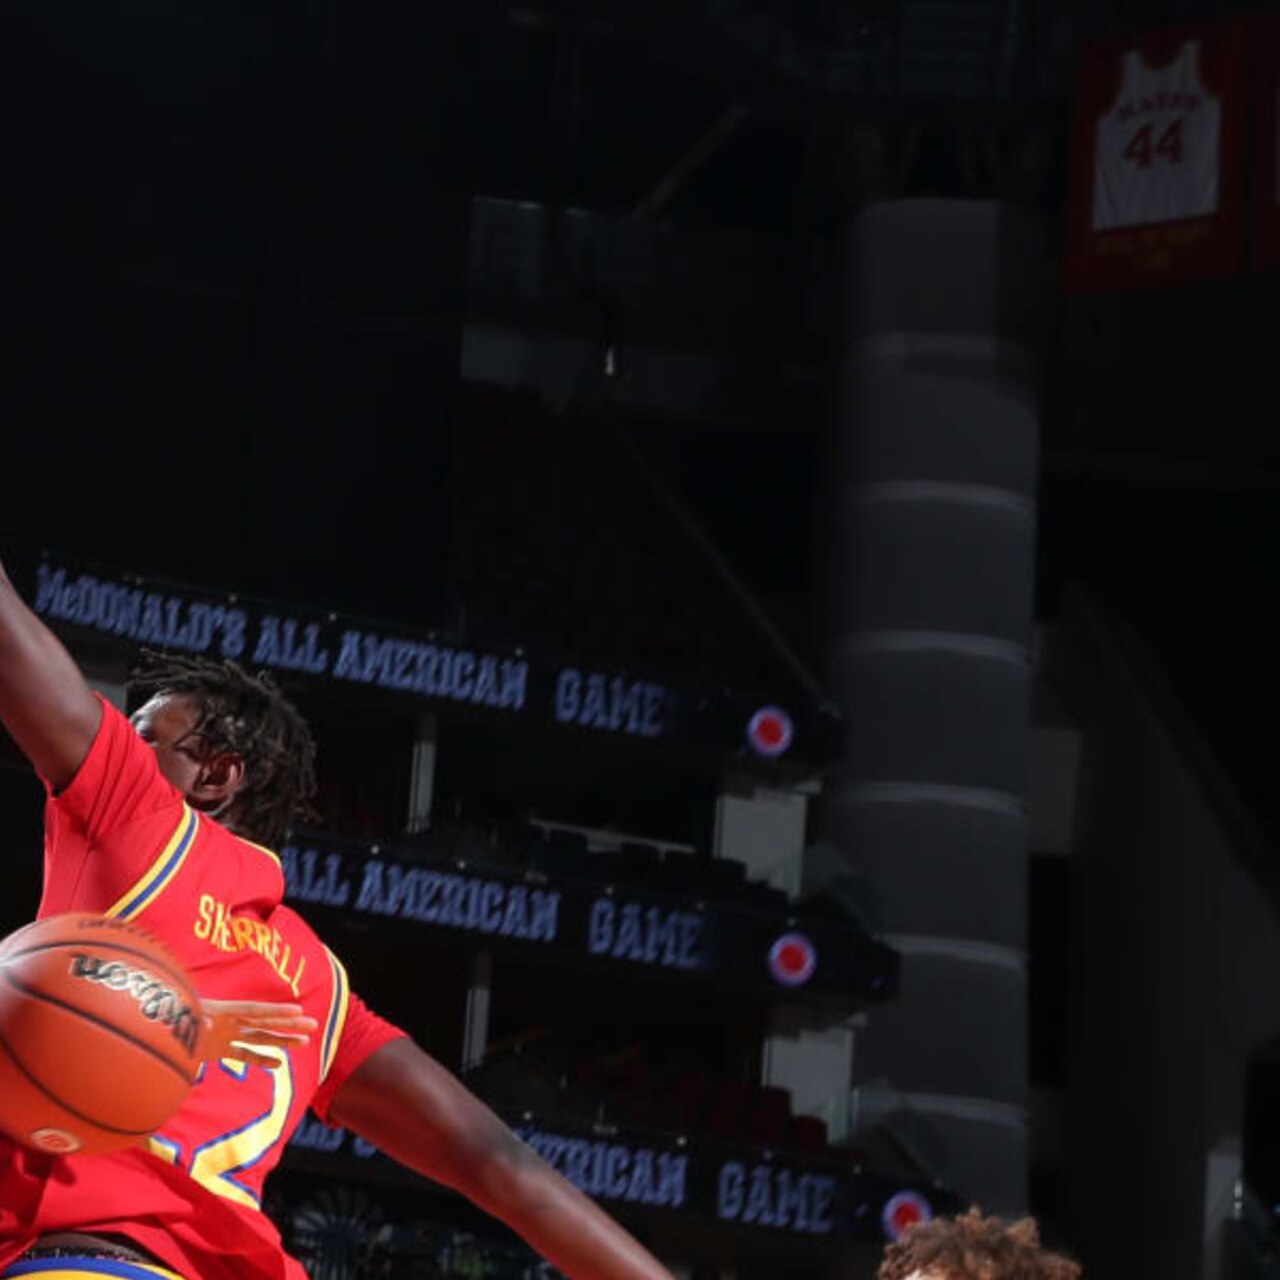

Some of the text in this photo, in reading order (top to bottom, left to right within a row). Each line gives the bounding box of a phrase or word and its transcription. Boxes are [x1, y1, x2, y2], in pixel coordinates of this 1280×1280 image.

[1123, 118, 1183, 170] 44
[251, 614, 330, 675] ALL
[332, 628, 530, 713] AMERICAN
[554, 667, 666, 740] GAME
[193, 892, 306, 999] SHERRELL
[354, 858, 563, 943] AMERICAN
[587, 897, 703, 971] GAME
[717, 1159, 837, 1235] GAME
